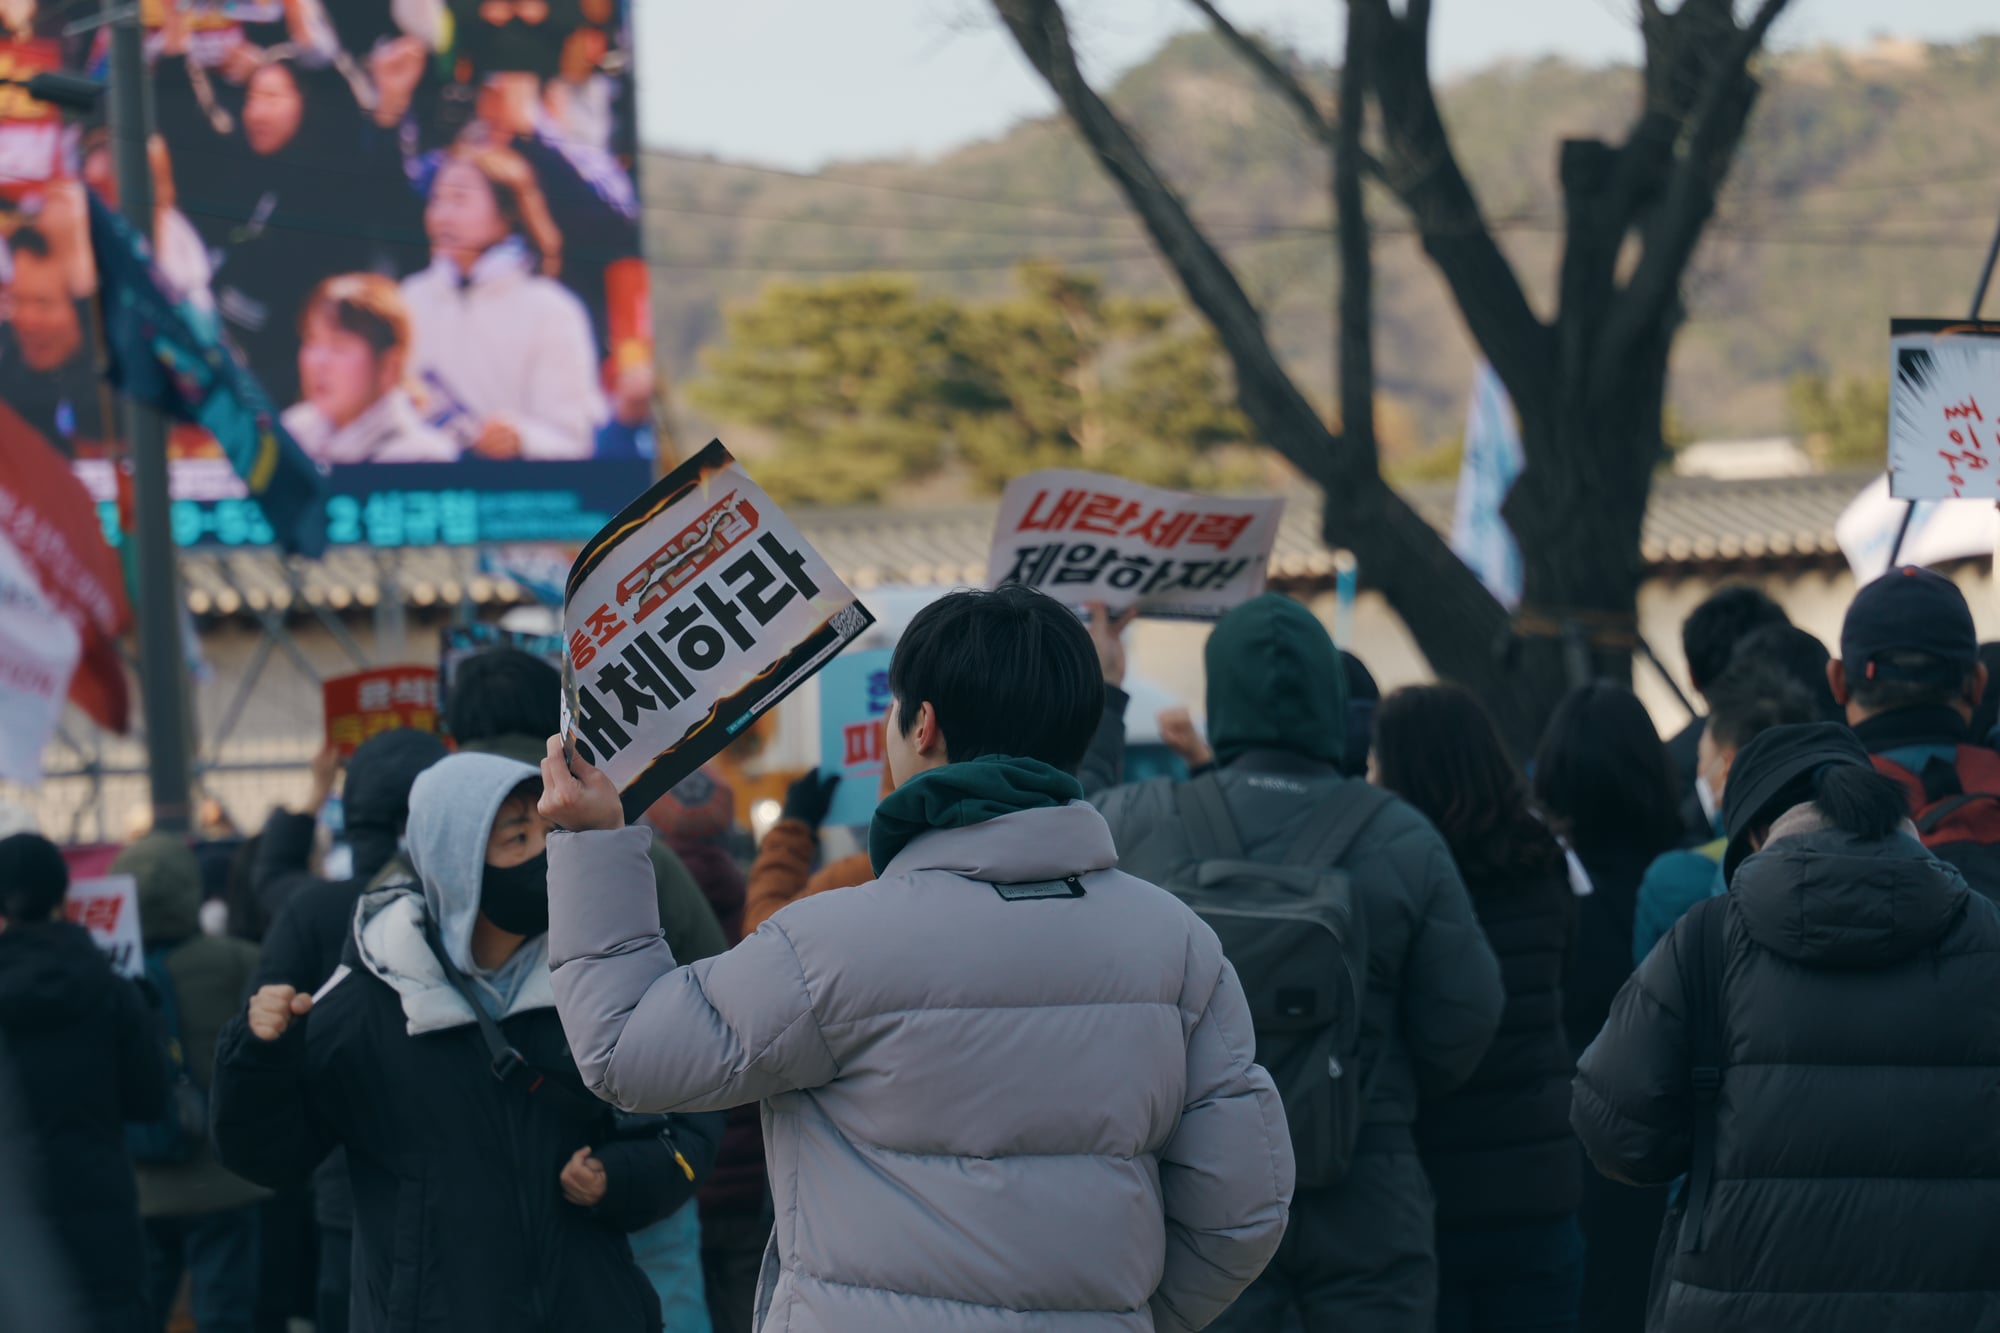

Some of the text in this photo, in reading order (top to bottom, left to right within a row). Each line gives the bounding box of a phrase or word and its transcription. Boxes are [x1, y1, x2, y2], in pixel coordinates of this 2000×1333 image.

[1938, 394, 1989, 498] 업으로
[1016, 488, 1254, 552] 내란세력
[1001, 542, 1247, 594] 제압하자!
